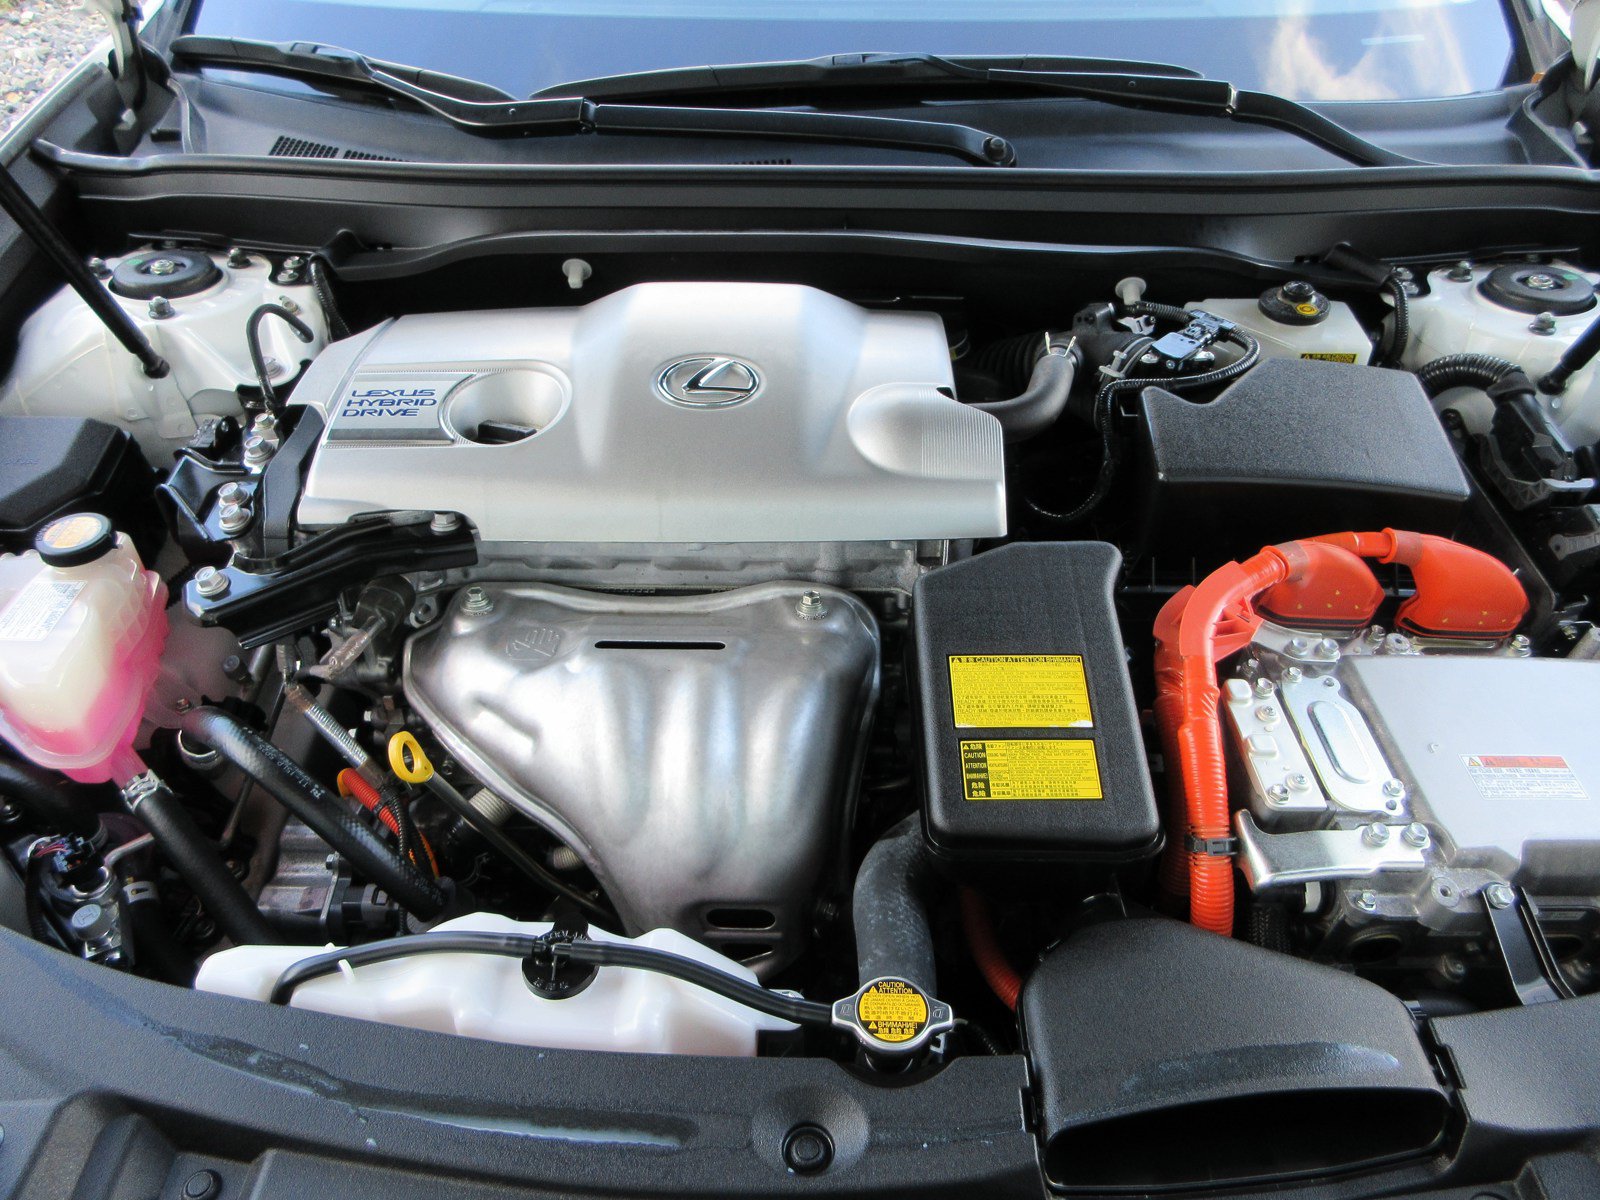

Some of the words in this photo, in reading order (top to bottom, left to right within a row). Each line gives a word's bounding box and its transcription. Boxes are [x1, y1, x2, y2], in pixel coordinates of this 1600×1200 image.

[352, 389, 436, 397] LEXUS
[347, 399, 437, 407] HYBRID
[342, 409, 420, 417] DRIVE
[878, 1021, 918, 1029] ВНИМАНИЕ!
